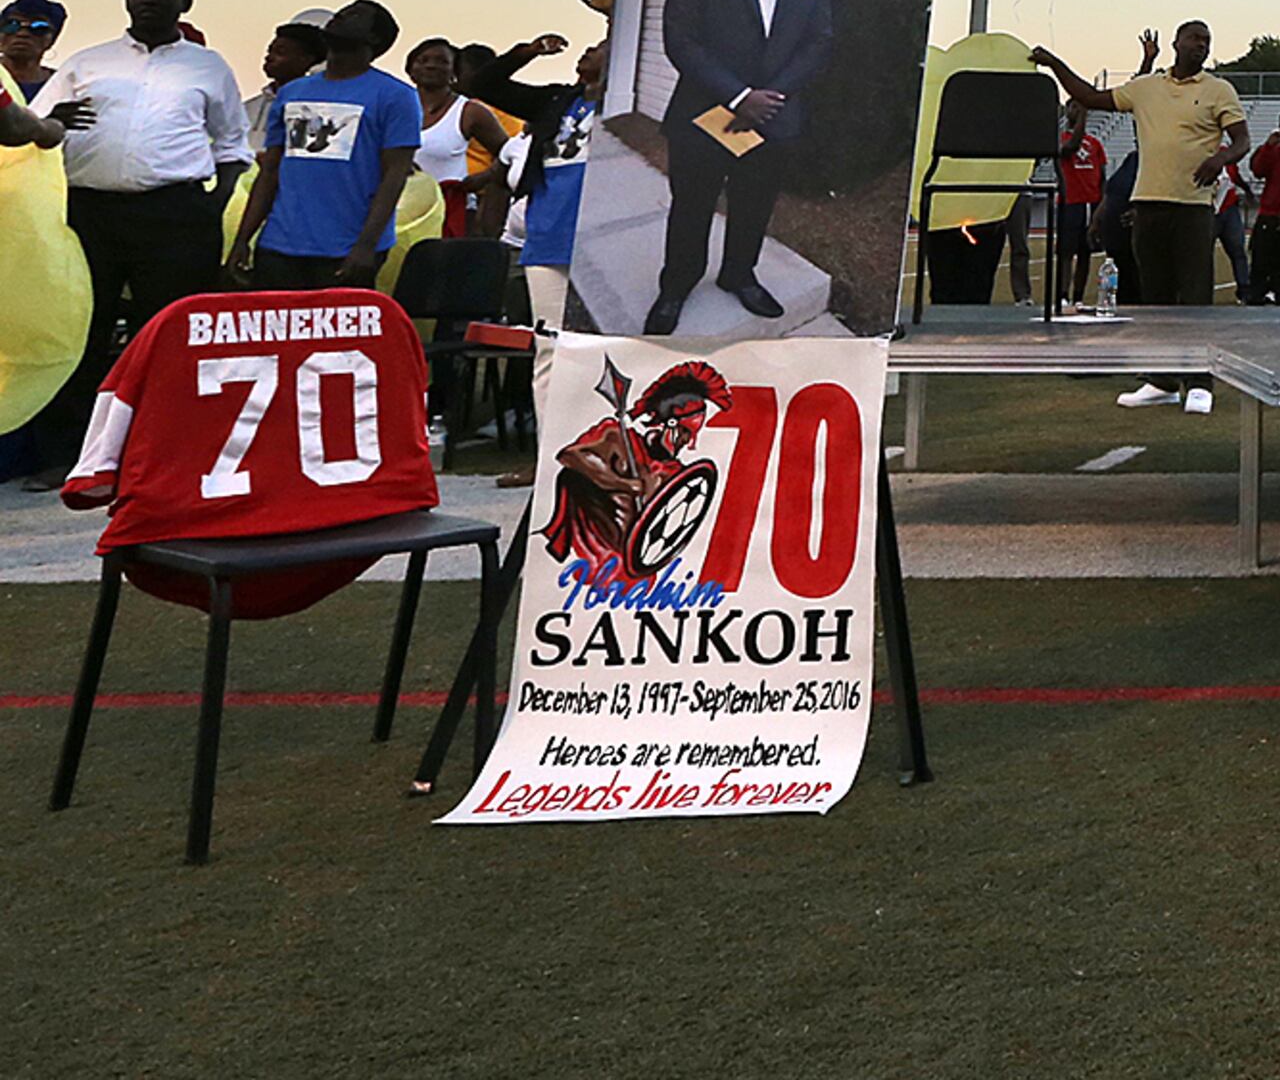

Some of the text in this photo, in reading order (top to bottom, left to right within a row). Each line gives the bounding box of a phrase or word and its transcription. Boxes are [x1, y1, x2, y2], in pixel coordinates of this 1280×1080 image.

[187, 304, 383, 346] BANNEKER
[197, 349, 382, 499] 70
[698, 382, 863, 599] 70
[558, 557, 726, 612] Ibrahim
[530, 608, 854, 667] SANKOH
[518, 680, 609, 714] December
[609, 683, 632, 720] 13,
[538, 734, 822, 769] Heroes are remembered.
[471, 768, 834, 817] Legends live forever.
